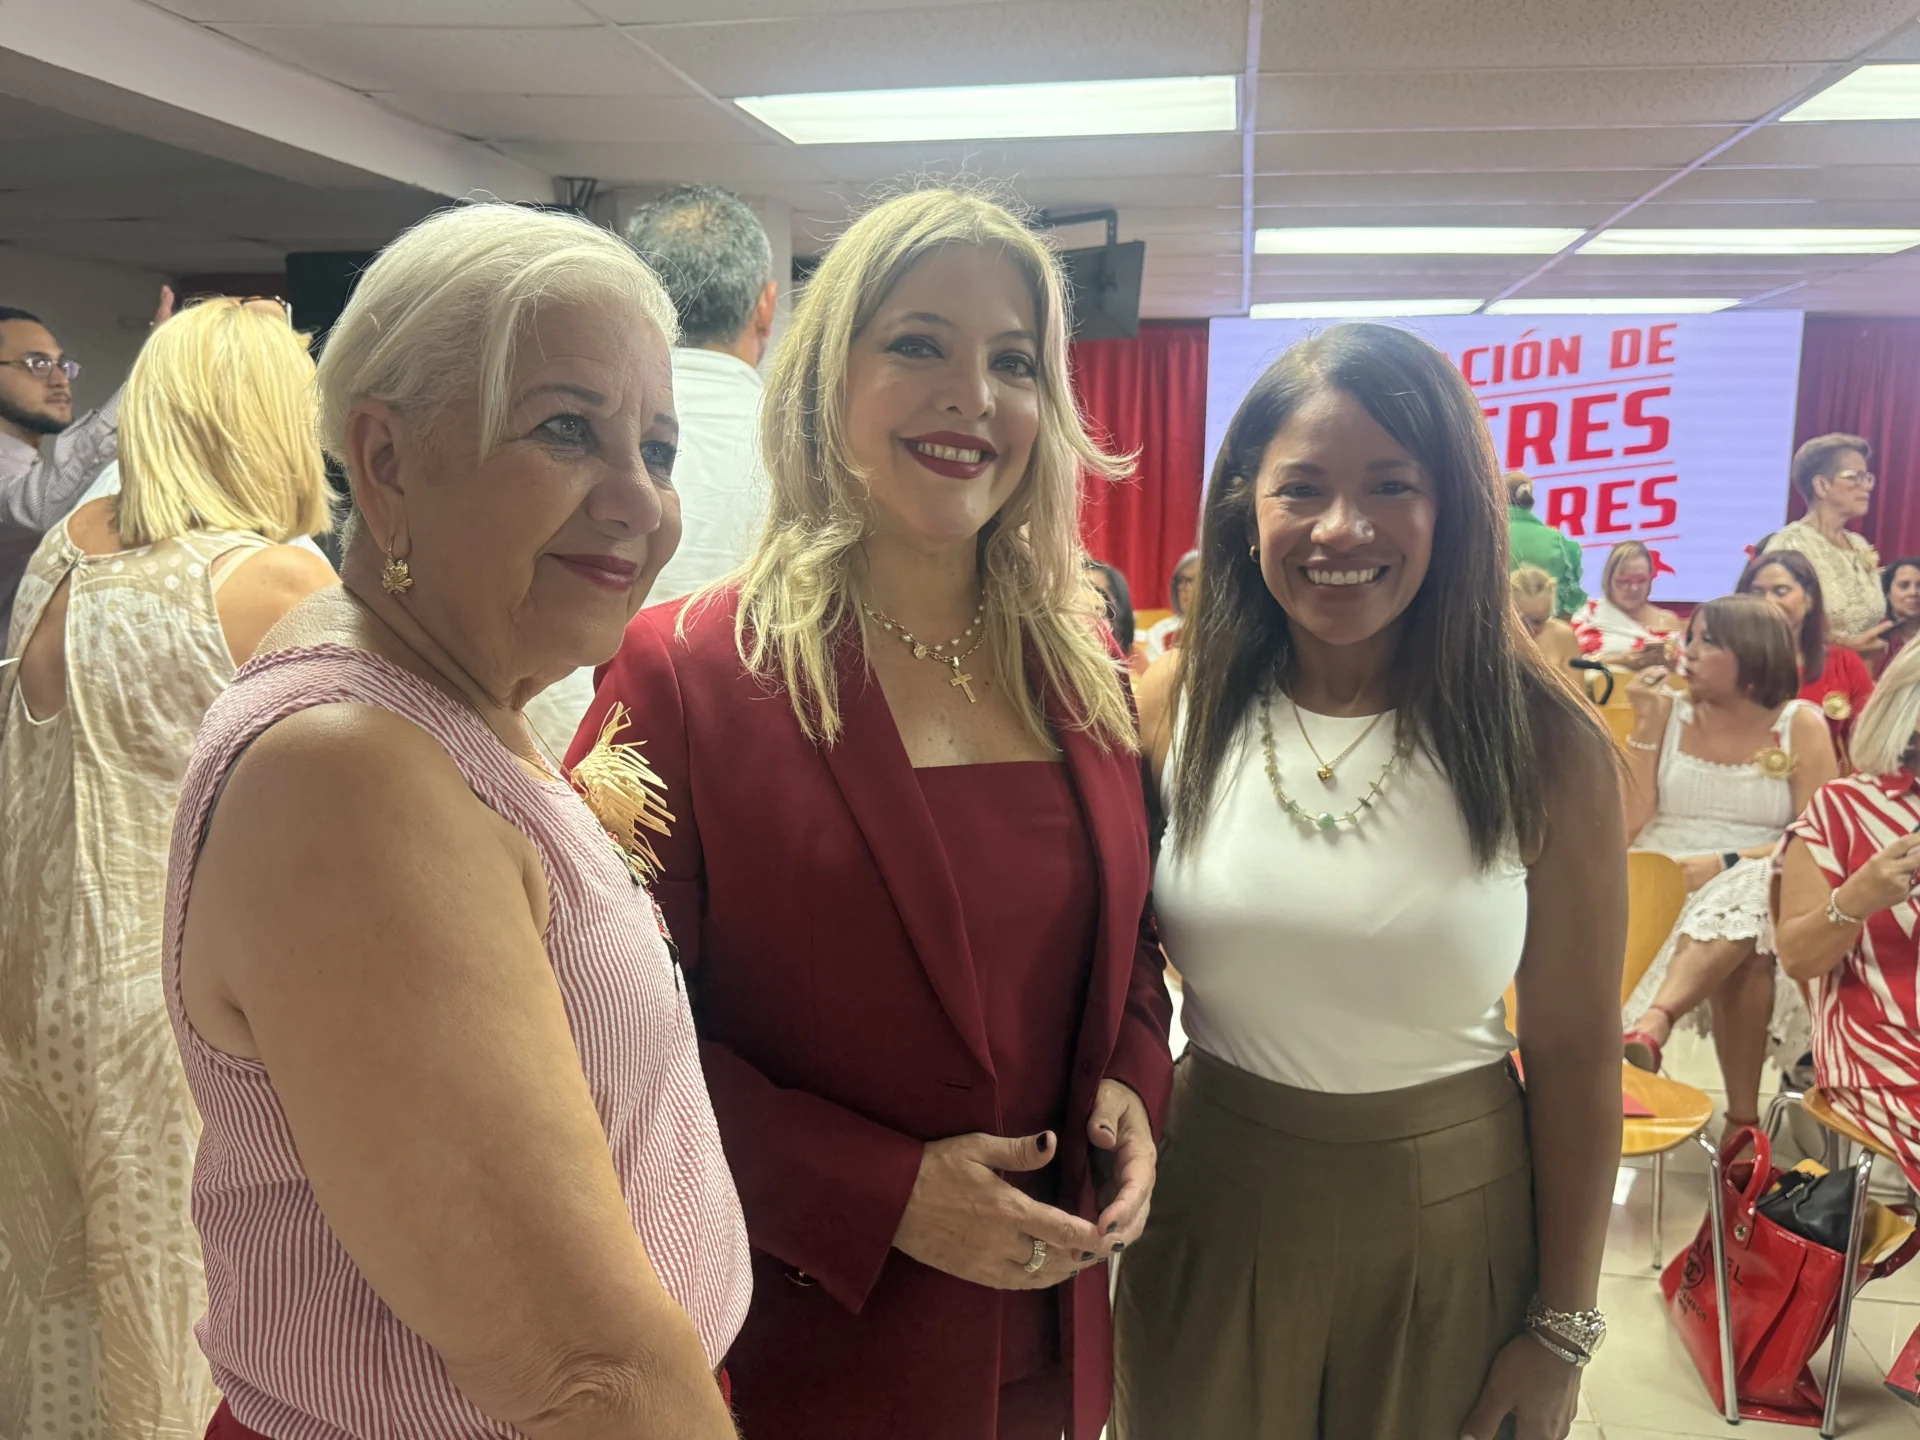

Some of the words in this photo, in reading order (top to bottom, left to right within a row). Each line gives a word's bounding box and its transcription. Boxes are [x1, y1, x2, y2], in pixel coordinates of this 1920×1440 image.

[1443, 327, 1581, 387] CIÓN
[1610, 323, 1678, 370] DE
[1483, 386, 1671, 468] RES
